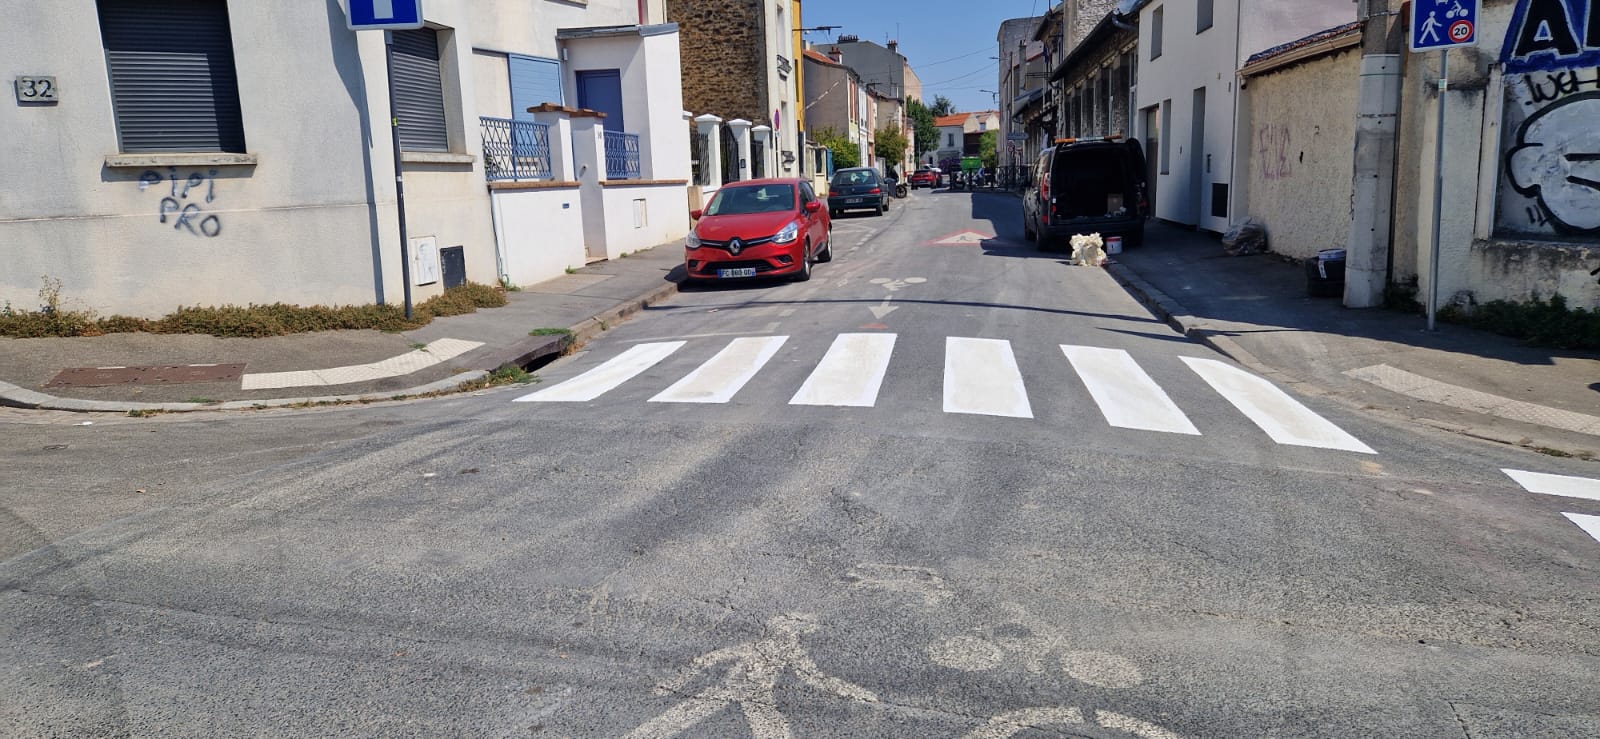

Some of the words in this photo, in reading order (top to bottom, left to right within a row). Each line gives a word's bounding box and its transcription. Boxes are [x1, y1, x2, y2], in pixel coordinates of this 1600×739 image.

[1454, 27, 1468, 36] 20
[22, 79, 53, 97] 32
[160, 197, 221, 237] PRO
